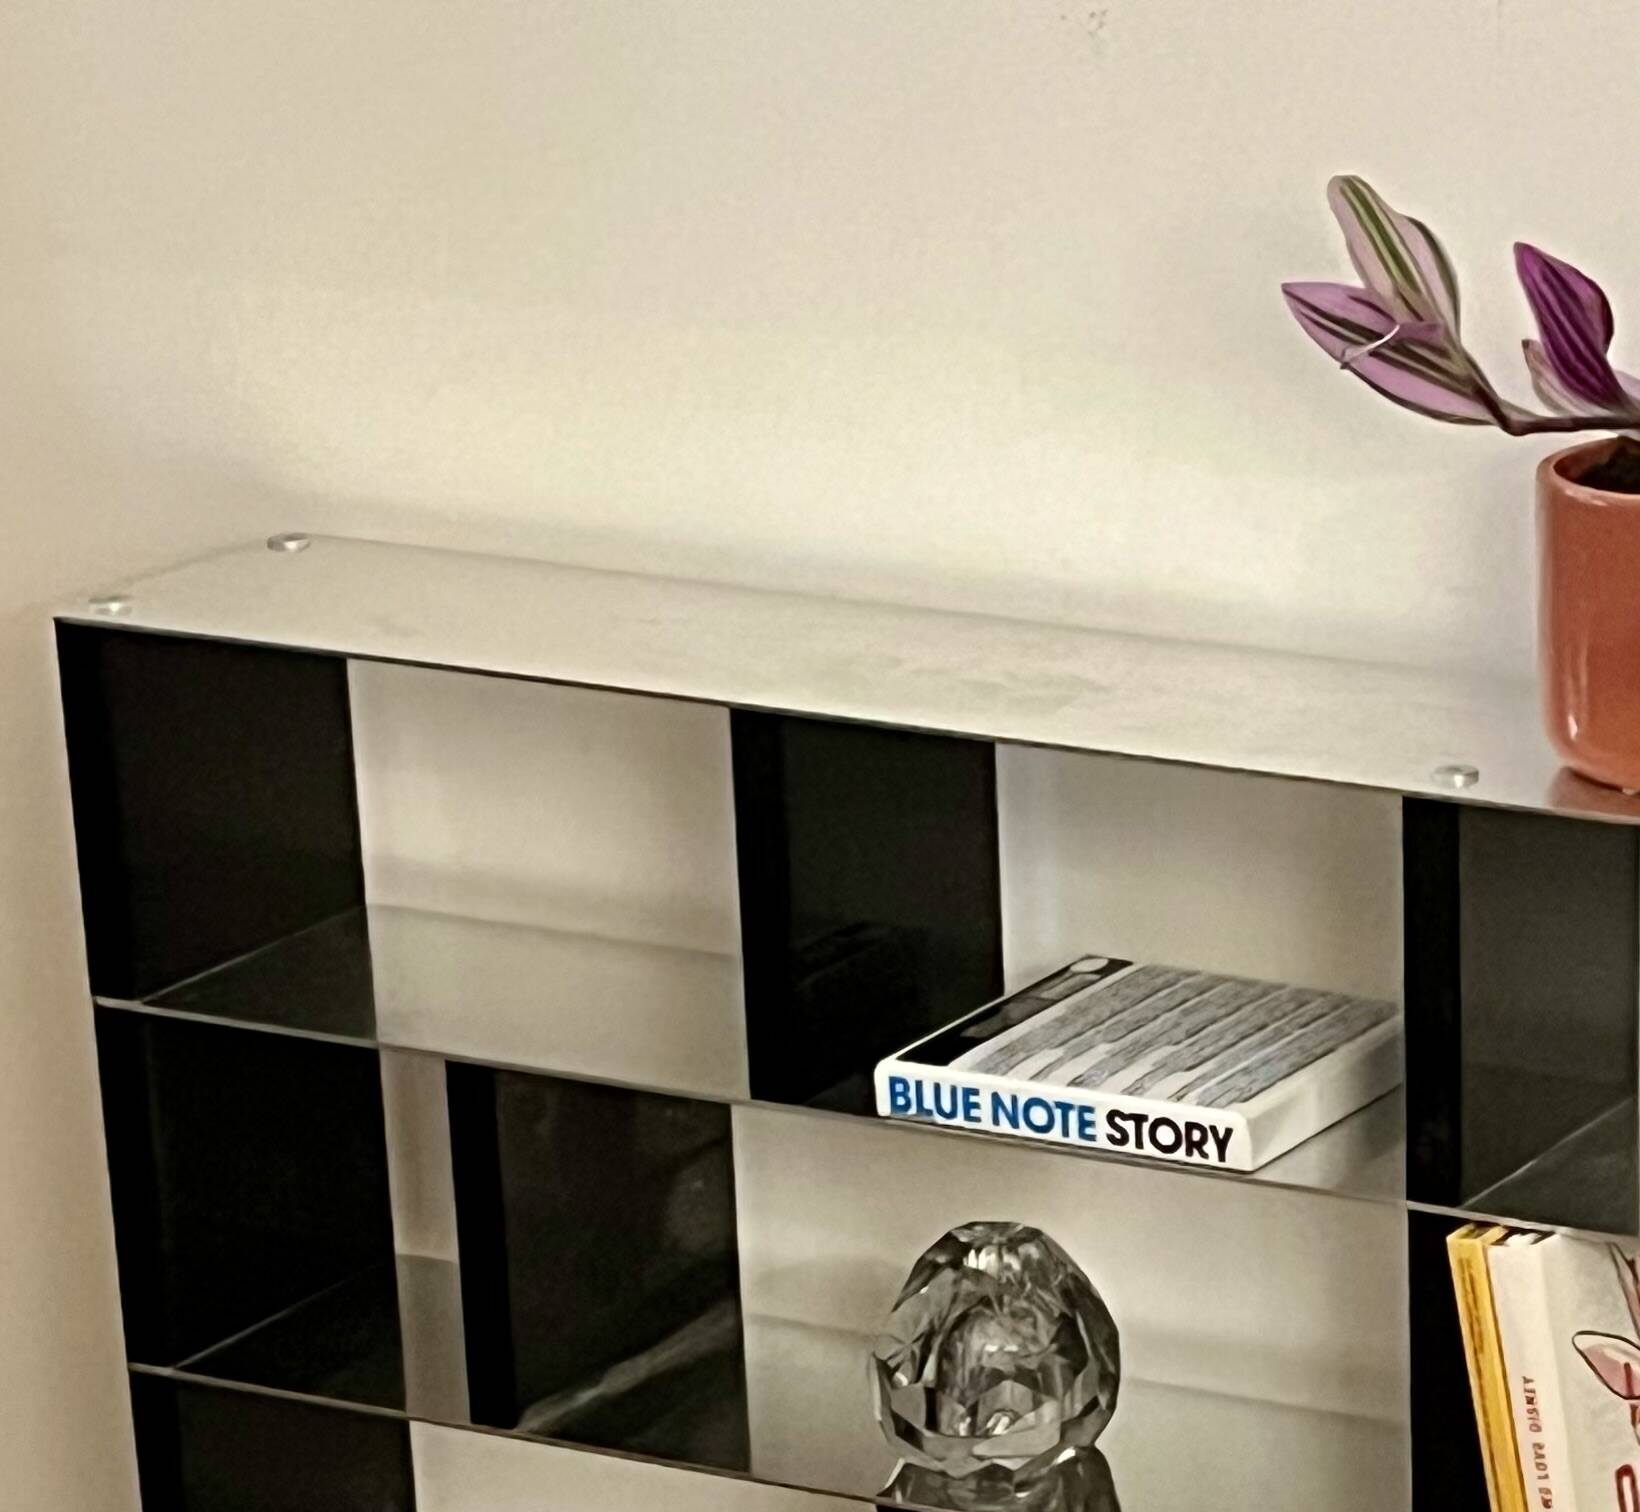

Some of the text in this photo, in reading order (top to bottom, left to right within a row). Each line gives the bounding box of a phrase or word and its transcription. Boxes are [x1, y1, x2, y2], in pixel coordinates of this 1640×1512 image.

[889, 1076, 1234, 1163] BLUE NOTE STORY
[1522, 1375, 1542, 1433] DISNEY
[1531, 1442, 1550, 1480] LOVE
